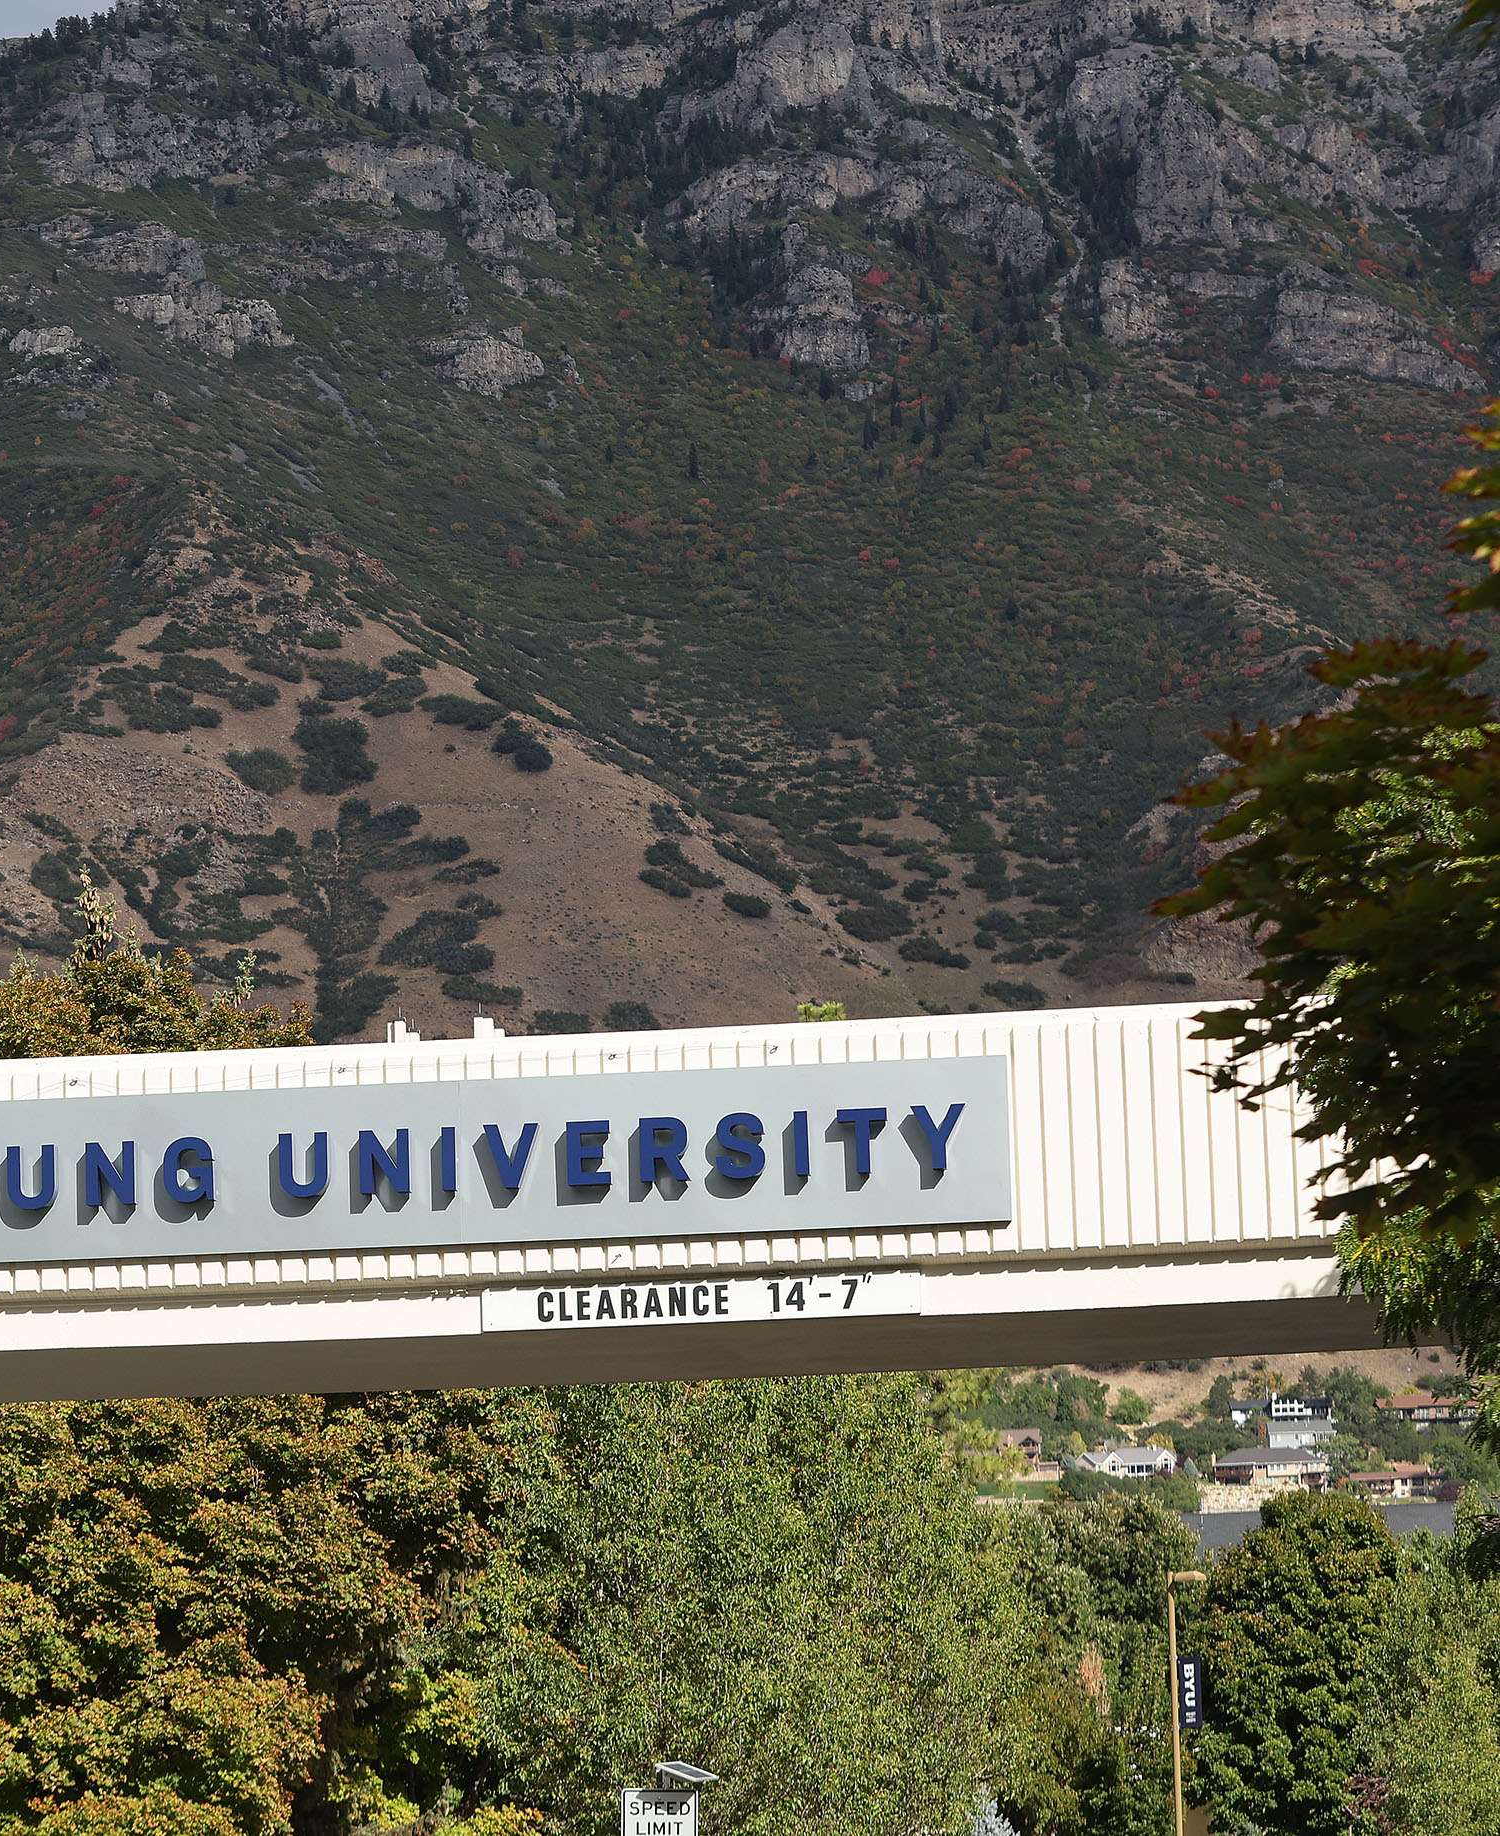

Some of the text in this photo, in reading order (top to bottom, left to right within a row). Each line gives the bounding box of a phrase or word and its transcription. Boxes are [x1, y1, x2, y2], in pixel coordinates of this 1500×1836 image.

[279, 1103, 966, 1198] UNIVERSITY
[536, 1284, 730, 1322] CLEARANCE
[1183, 1663, 1196, 1707] BYU
[629, 1801, 691, 1815] SPEED
[636, 1821, 684, 1836] LIMIT
